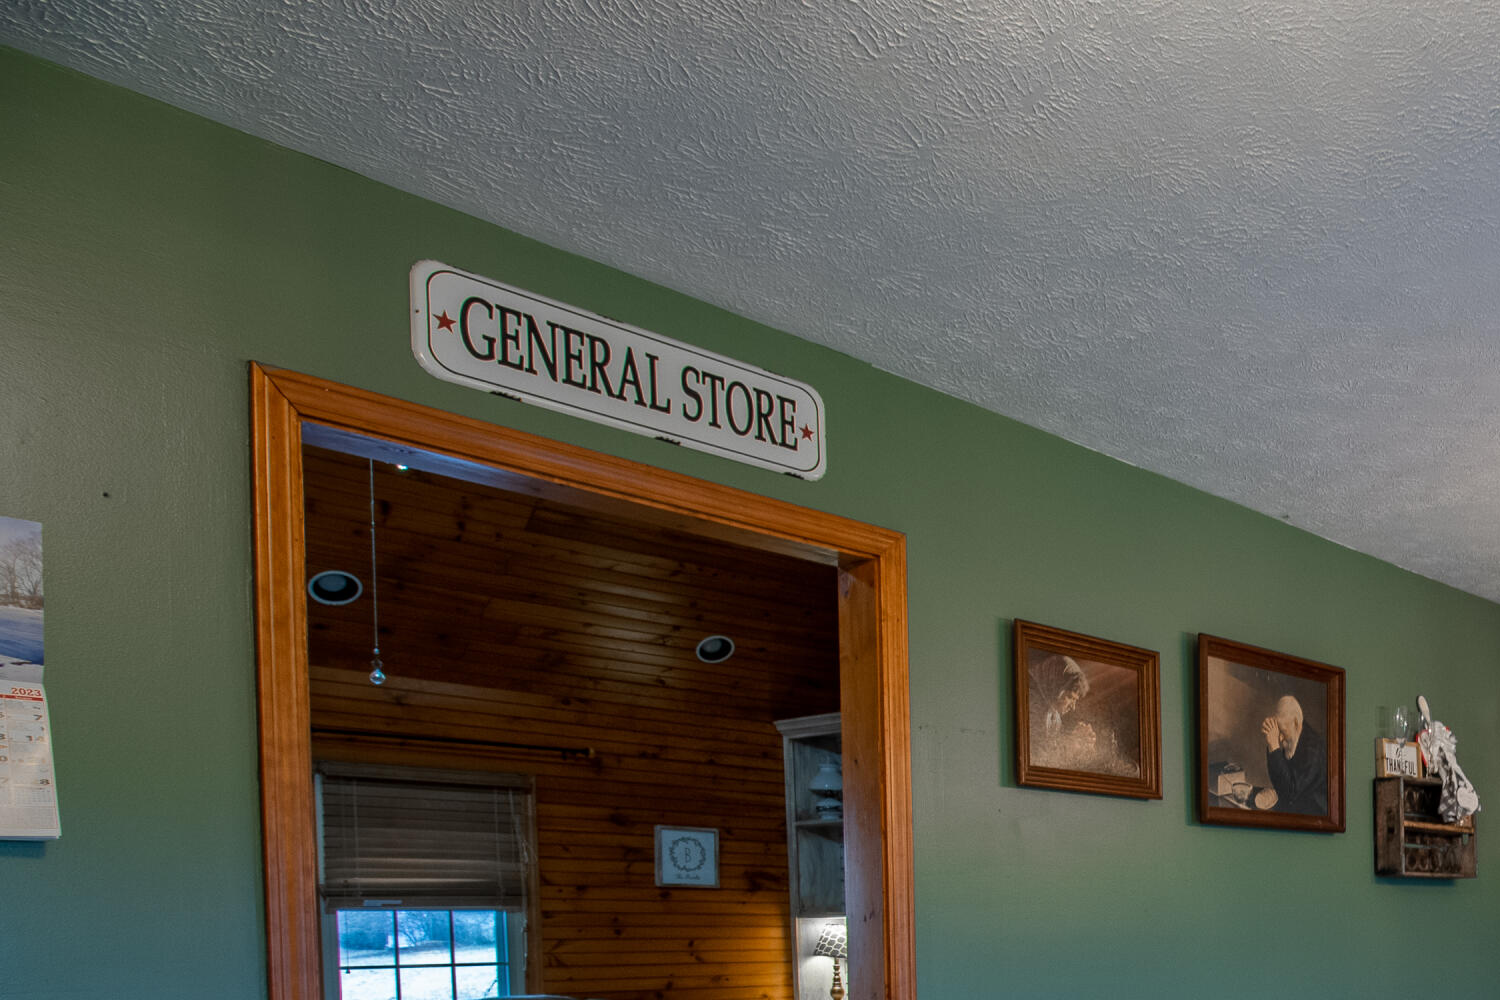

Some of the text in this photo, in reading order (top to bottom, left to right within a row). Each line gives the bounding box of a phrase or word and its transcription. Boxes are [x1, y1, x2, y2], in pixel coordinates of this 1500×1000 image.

[459, 296, 799, 452] GENERAL STORE
[11, 687, 42, 697] 2023
[684, 847, 692, 863] B
